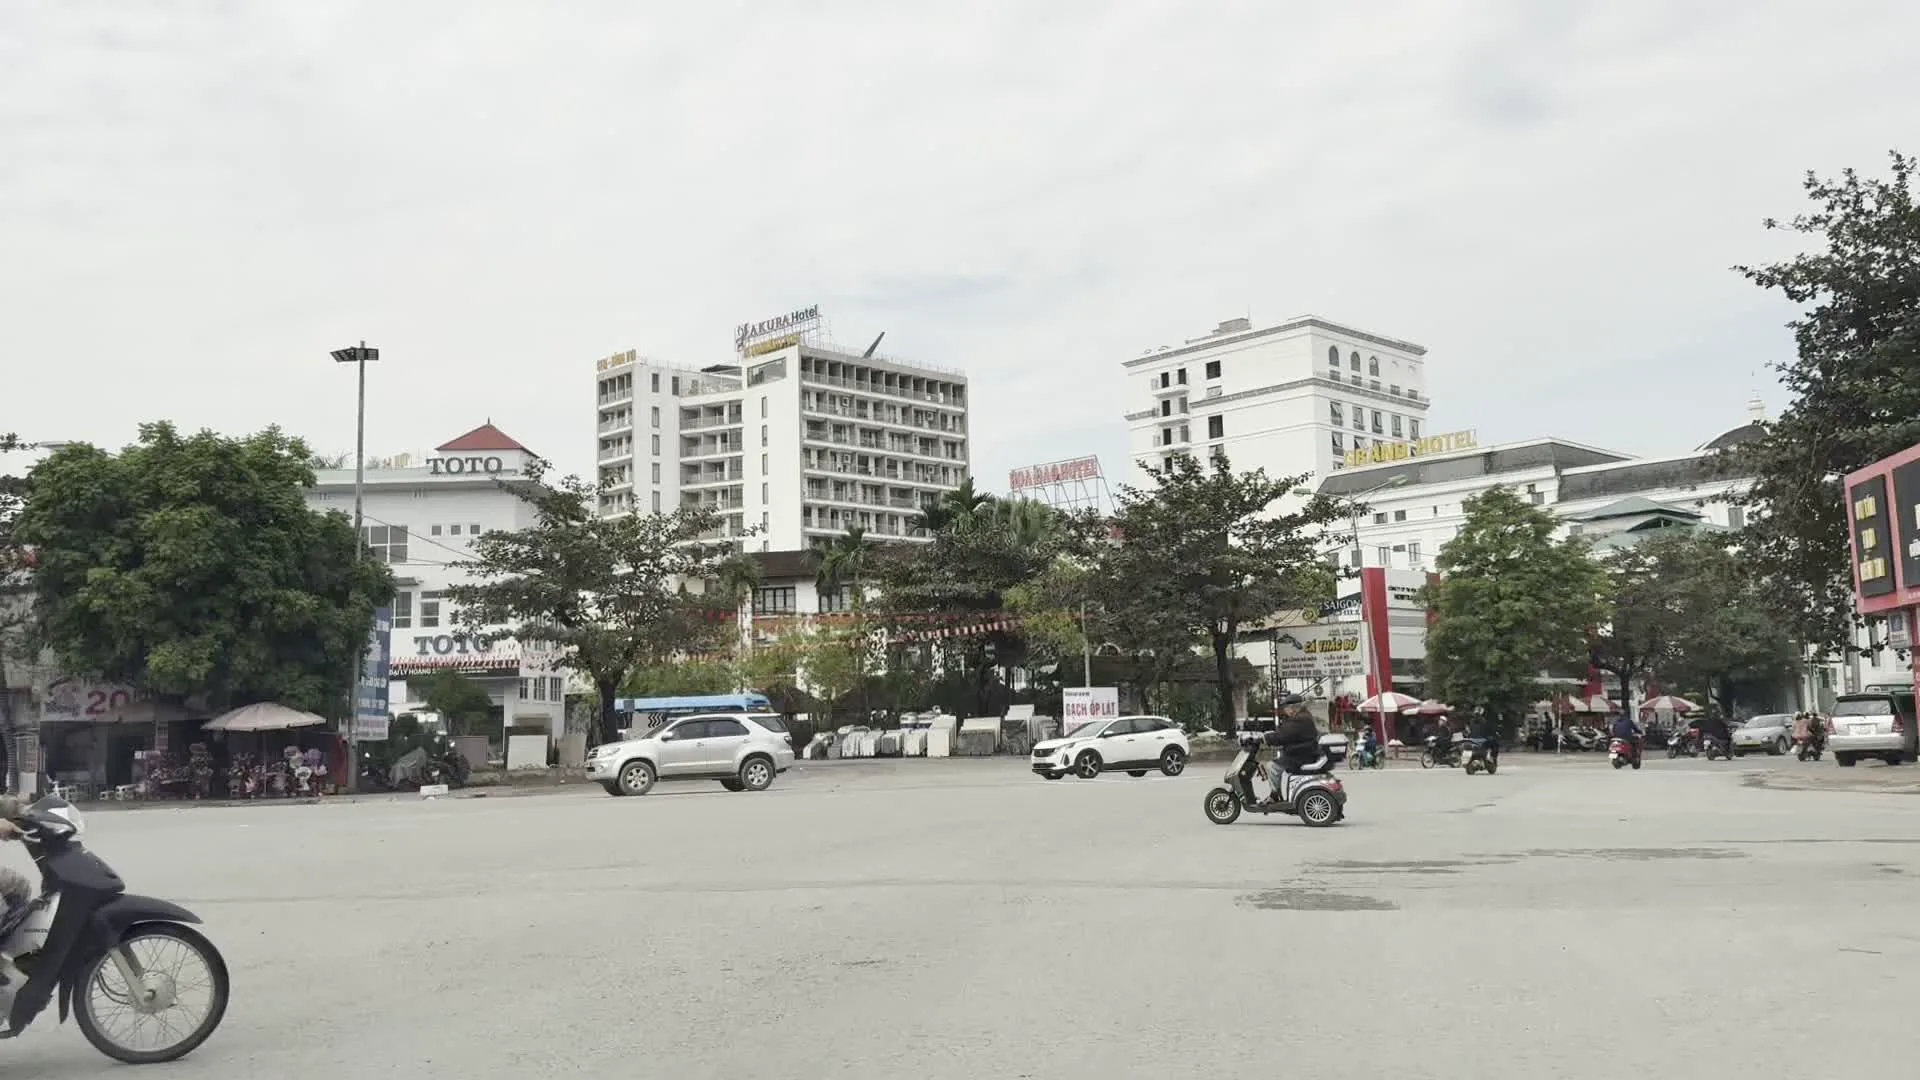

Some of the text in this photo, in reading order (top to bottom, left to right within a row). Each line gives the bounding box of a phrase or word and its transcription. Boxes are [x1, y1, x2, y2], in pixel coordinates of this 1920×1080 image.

[735, 314, 789, 349] SAKURA
[791, 304, 818, 322] Hotel
[1344, 431, 1476, 466] GRAND HOTEL
[425, 456, 503, 475] TOTO
[1323, 600, 1361, 611] SAIGON
[414, 635, 492, 656] TOTO
